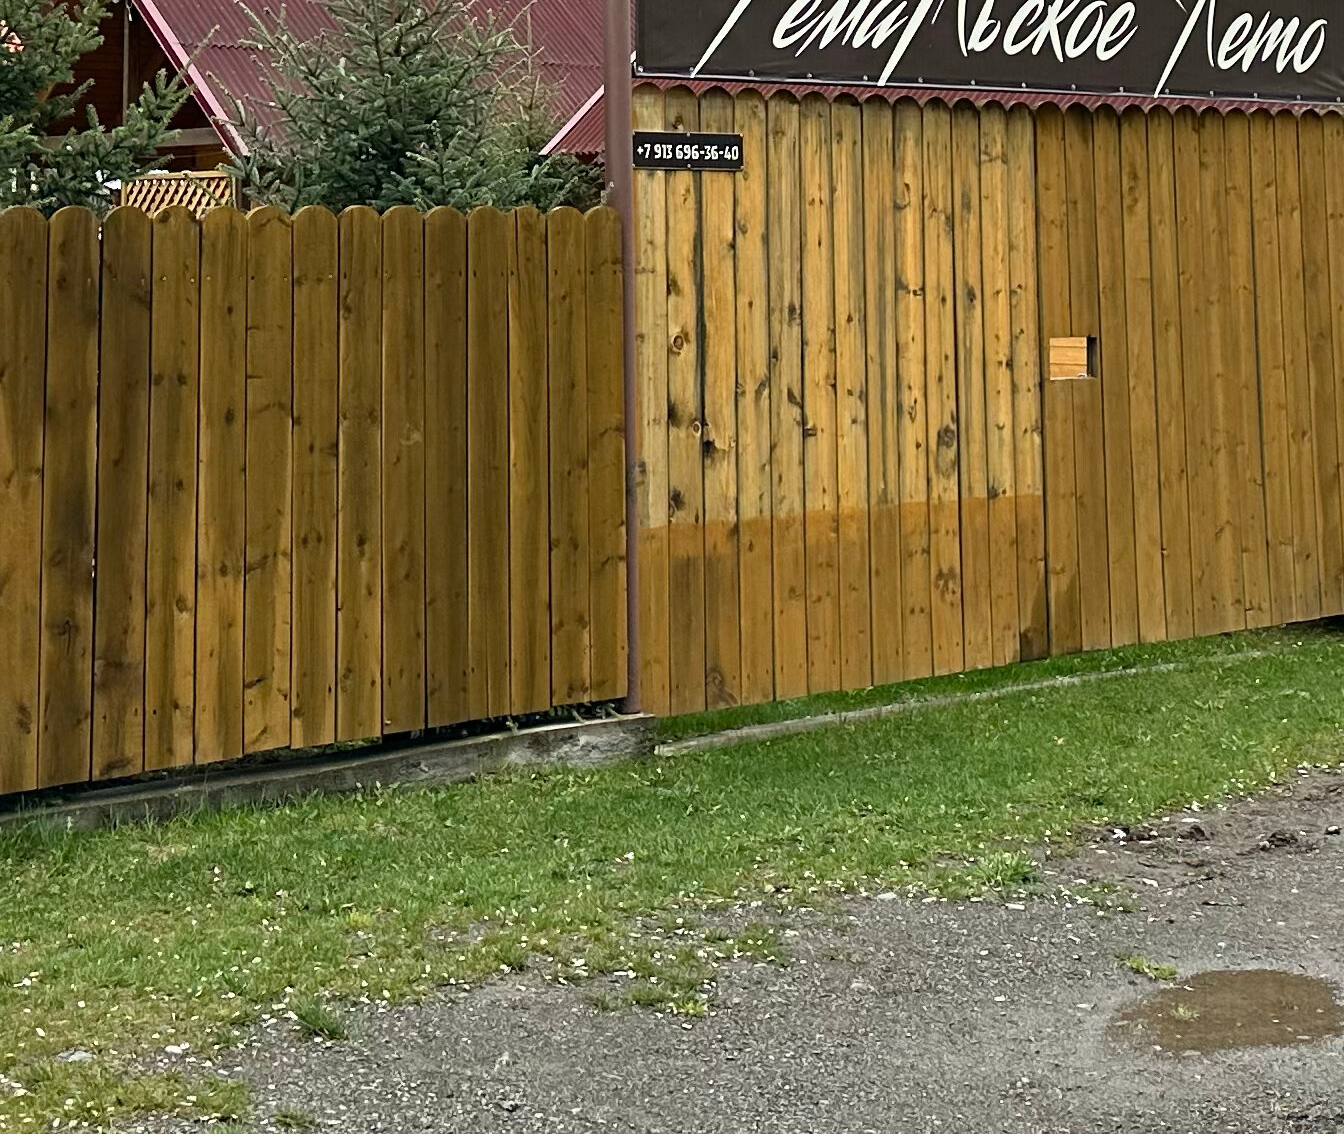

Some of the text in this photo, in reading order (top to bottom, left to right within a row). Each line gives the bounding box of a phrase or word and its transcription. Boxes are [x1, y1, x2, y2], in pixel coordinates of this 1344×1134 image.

[637, 144, 739, 160] +7 913 696-36-40
